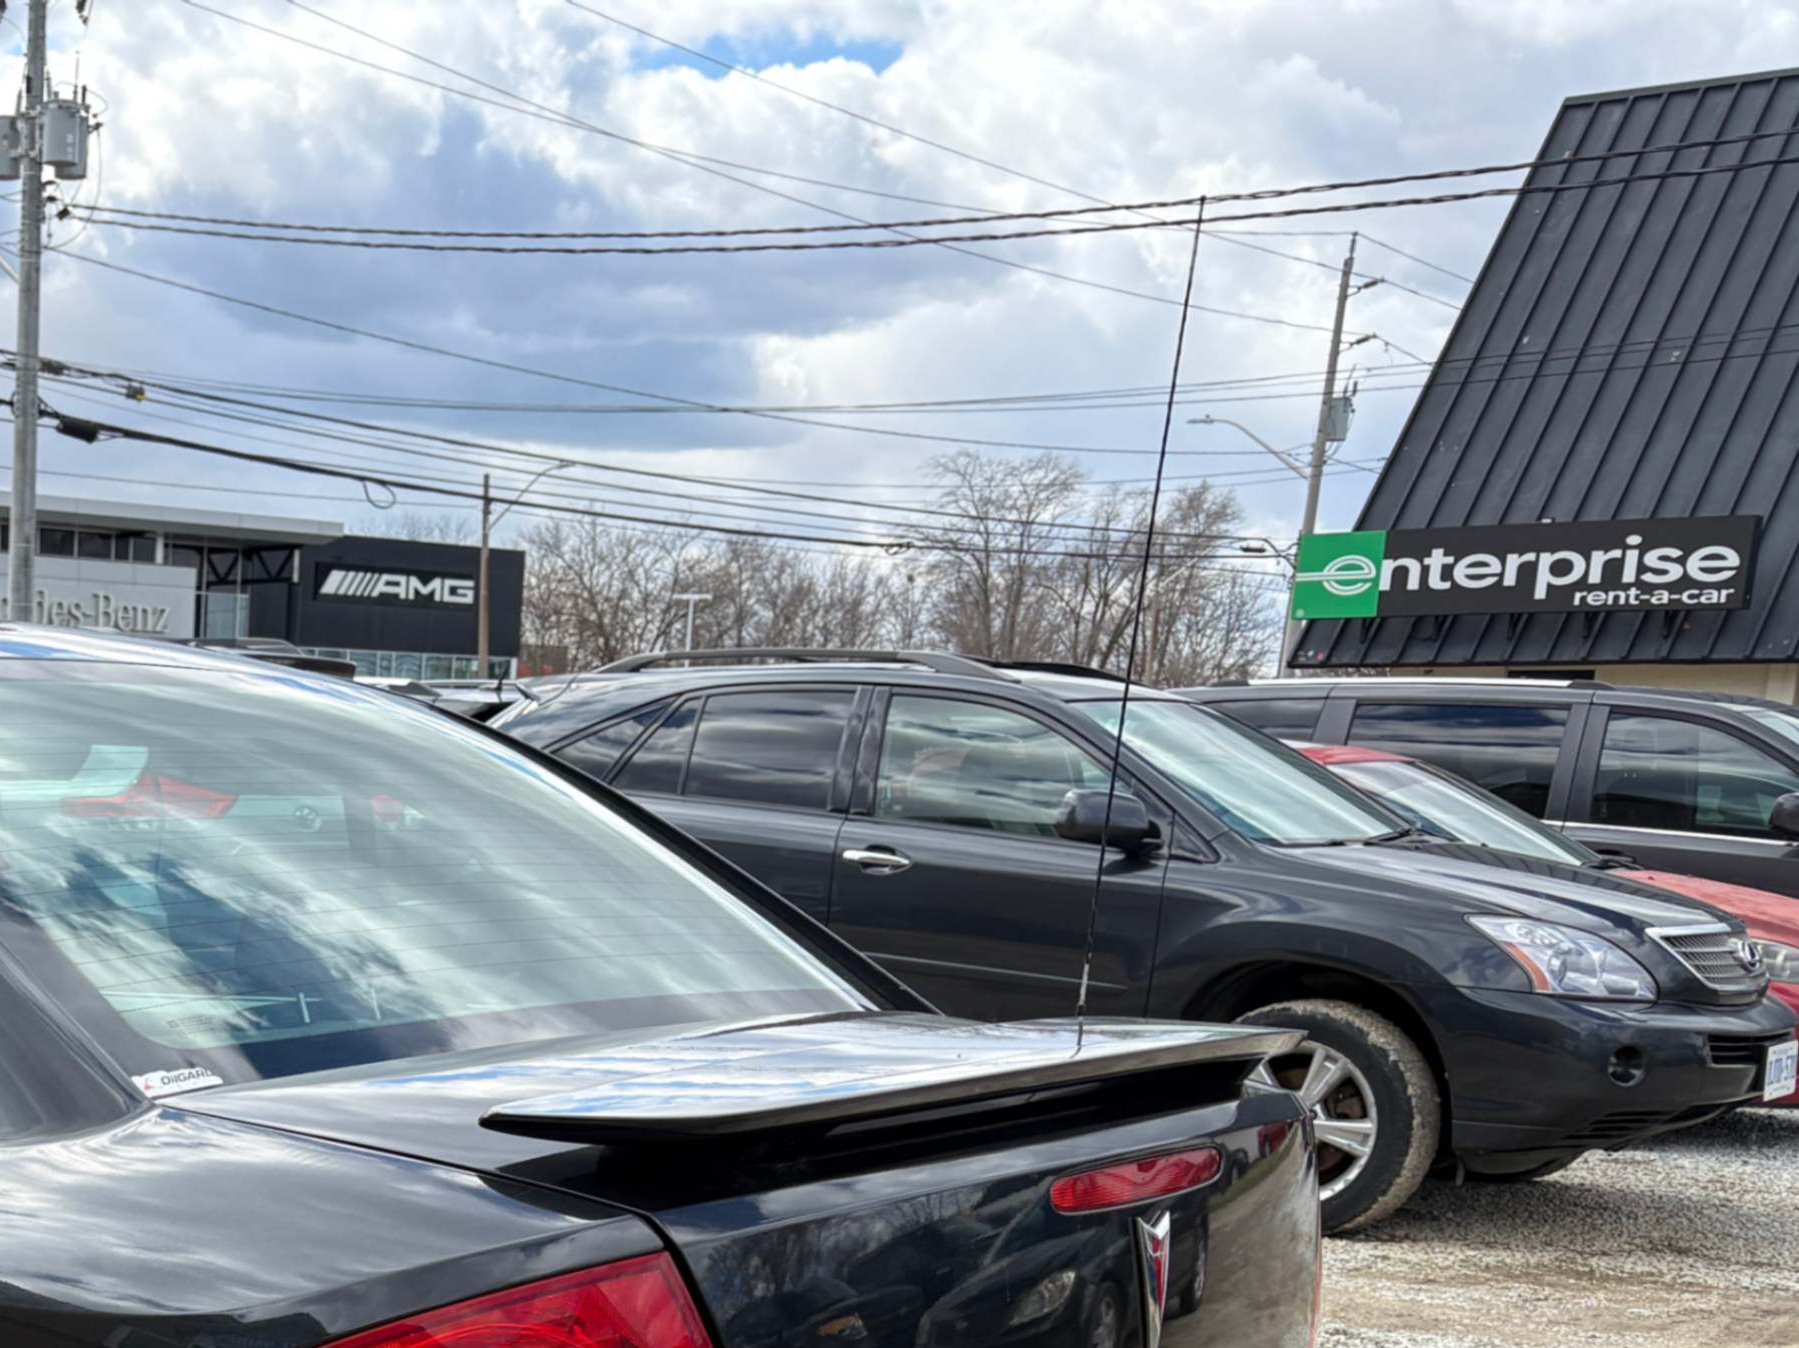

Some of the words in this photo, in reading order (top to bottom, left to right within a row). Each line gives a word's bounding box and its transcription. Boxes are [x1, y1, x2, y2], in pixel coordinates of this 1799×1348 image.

[1298, 534, 1741, 600] enterprise
[376, 572, 475, 604] AMG
[1573, 586, 1735, 607] rent-a-car
